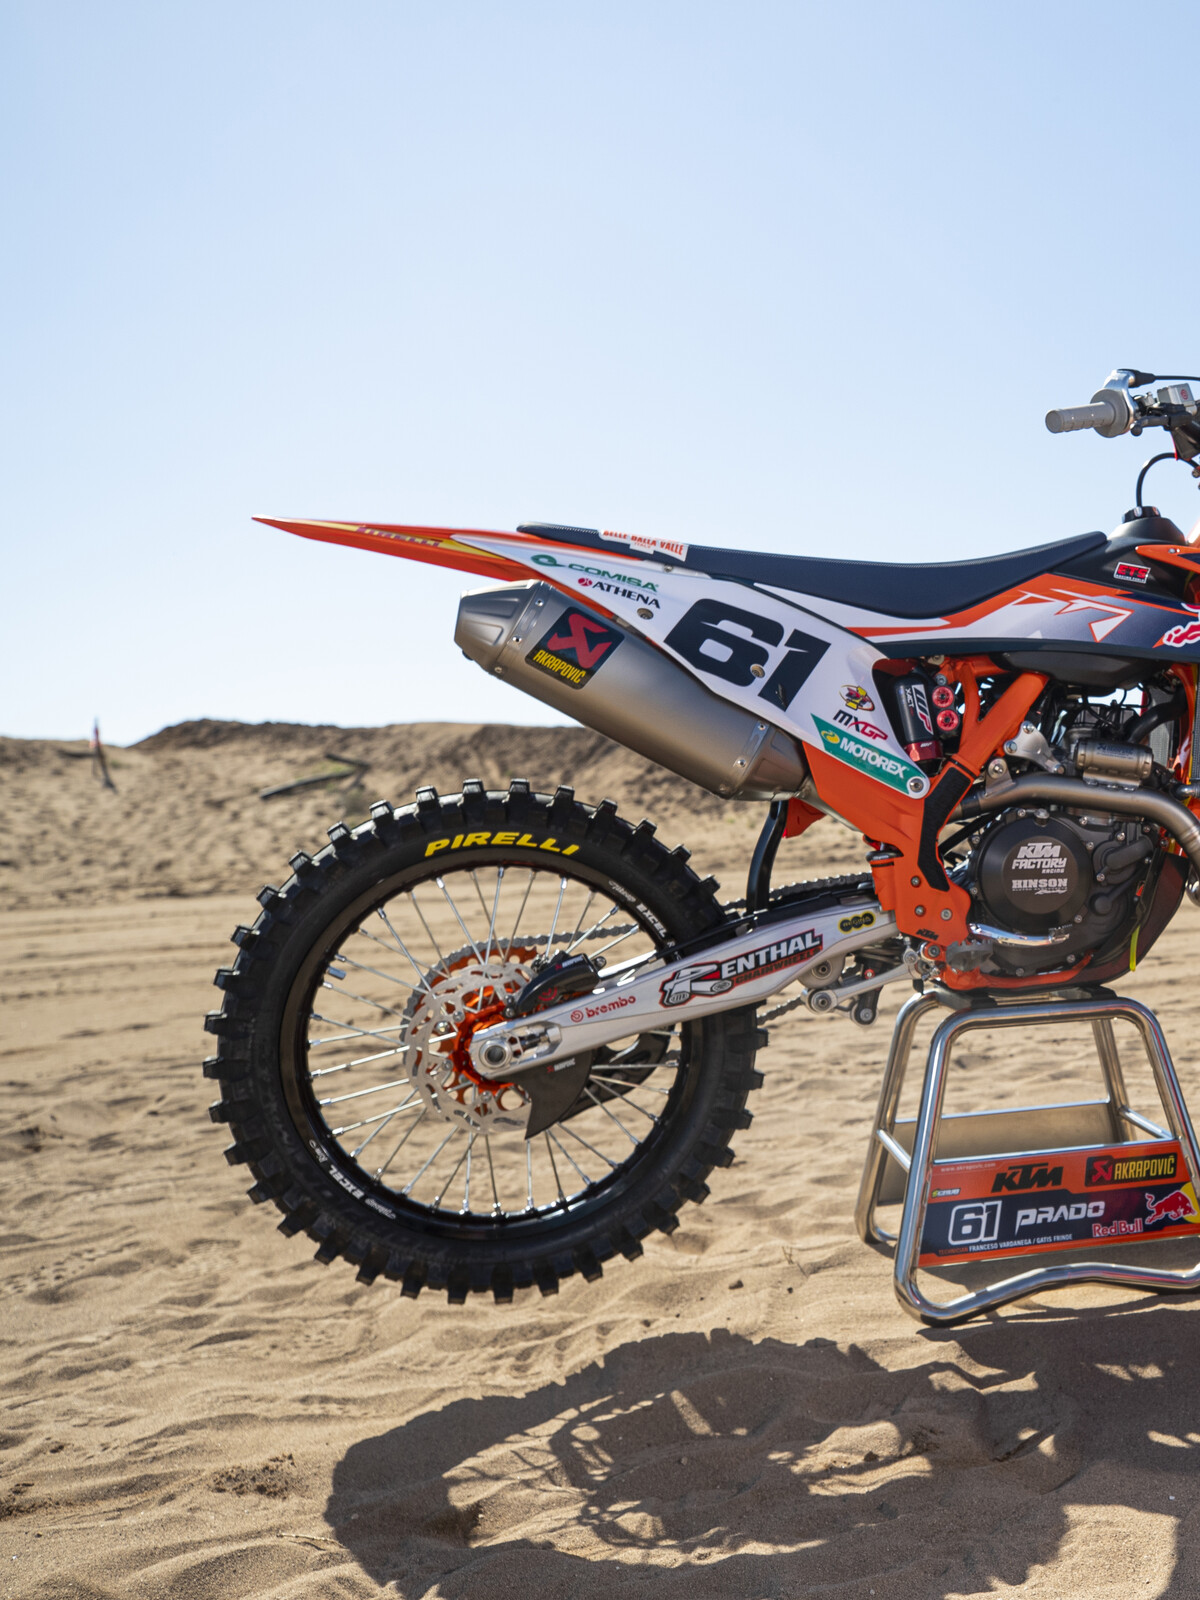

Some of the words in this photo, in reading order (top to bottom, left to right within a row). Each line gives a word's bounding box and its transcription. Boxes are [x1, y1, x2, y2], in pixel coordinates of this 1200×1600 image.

[660, 539, 684, 556] VALLE
[568, 563, 658, 592] COMISA
[1117, 564, 1148, 579] ETS
[592, 581, 661, 609] ATHENA
[663, 598, 831, 712] 61
[833, 709, 888, 741] MXGP
[839, 739, 908, 779] MOTOREX
[424, 831, 580, 857] PIRELLI
[1017, 842, 1061, 858] KTM
[1011, 857, 1067, 870] FACTORY
[1011, 878, 1068, 889] HINSON
[636, 902, 667, 938] EXCEL
[662, 931, 823, 1006] RENTHAL
[585, 996, 636, 1019] brembo
[990, 1162, 1064, 1193] KTM
[1114, 1155, 1175, 1181] AKRAPOVIČ
[947, 1200, 1002, 1246] 61
[1015, 1201, 1106, 1236] PRADO
[1092, 1219, 1118, 1238] Red
[1118, 1217, 1143, 1234] Bull
